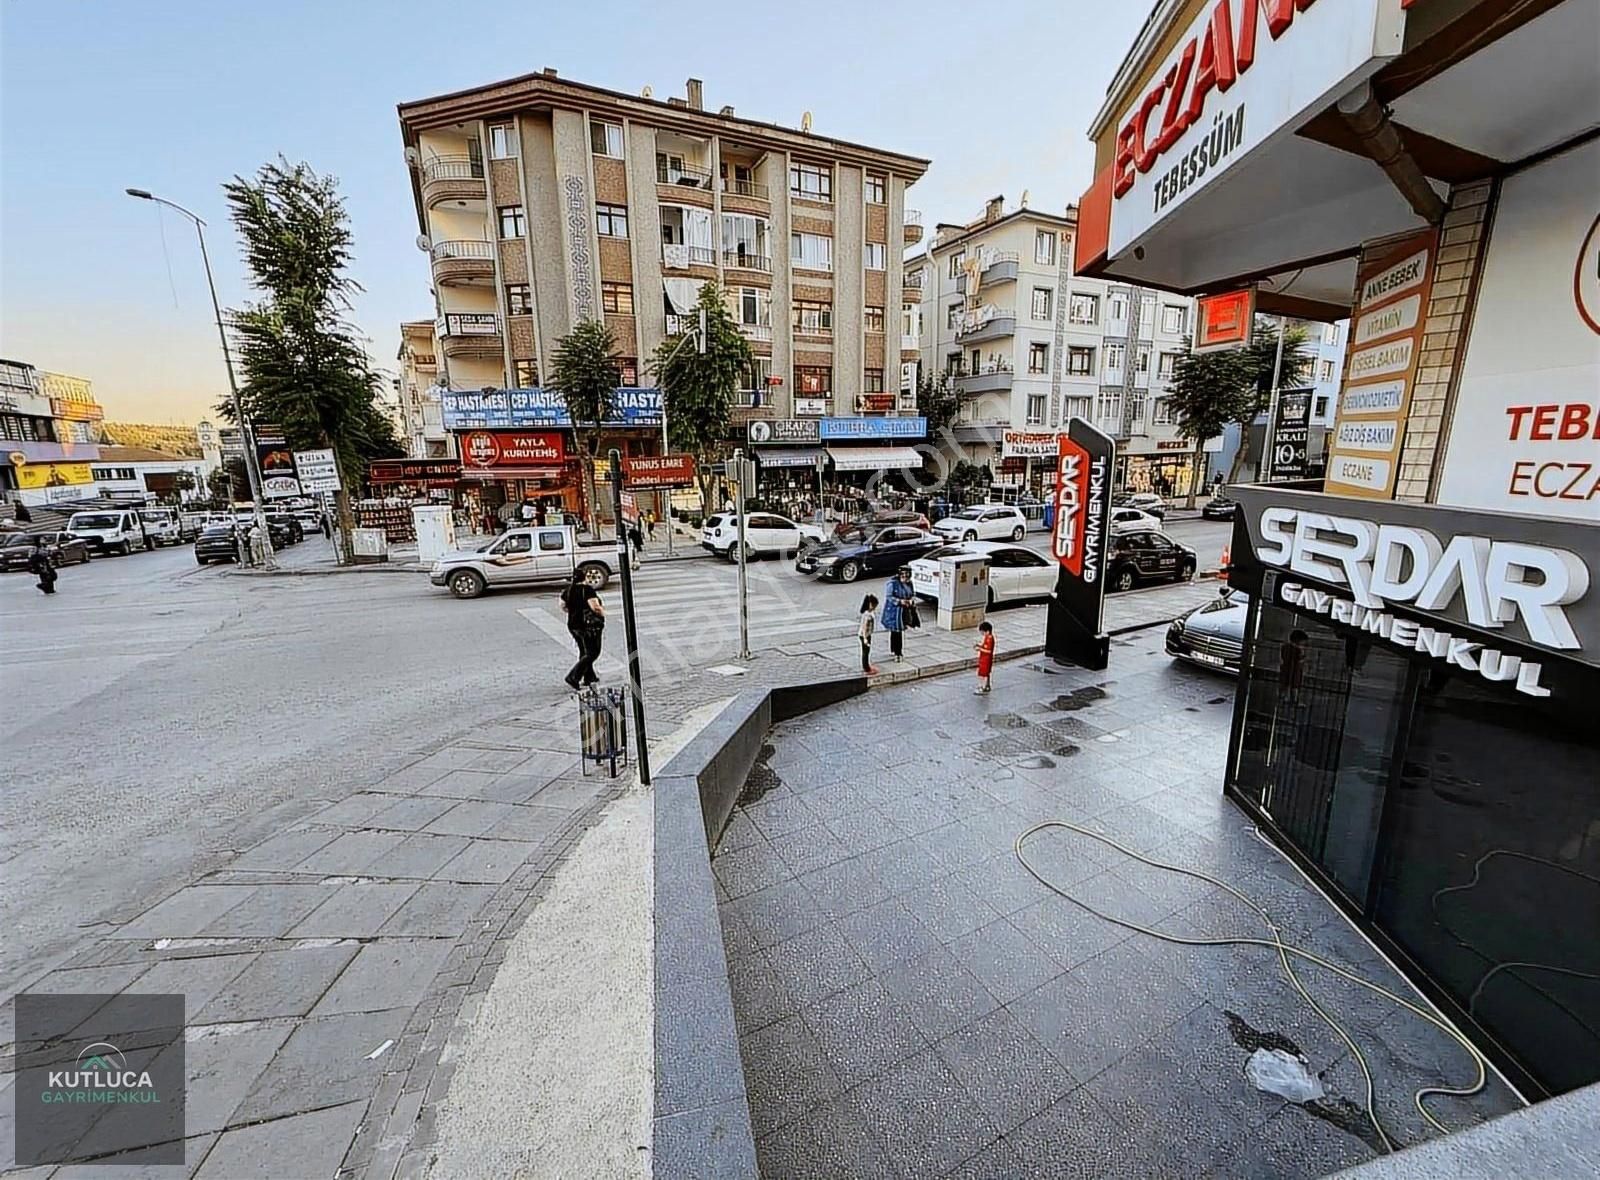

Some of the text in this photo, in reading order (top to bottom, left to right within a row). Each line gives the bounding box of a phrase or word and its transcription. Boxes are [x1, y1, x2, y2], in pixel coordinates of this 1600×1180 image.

[1153, 102, 1246, 214] TEBESSÜM
[1364, 259, 1421, 301] ANNE BEBEK
[511, 392, 528, 407] CEP
[503, 448, 558, 460] KURUYEMİŞ
[512, 437, 546, 448] YAYLA
[630, 457, 684, 471] YUNUS EMRE
[1342, 463, 1373, 481] ECZANE
[1056, 454, 1083, 559] SERDAR
[1083, 456, 1106, 583] GAYRİMENKUL
[1257, 506, 1590, 650] SERDAR
